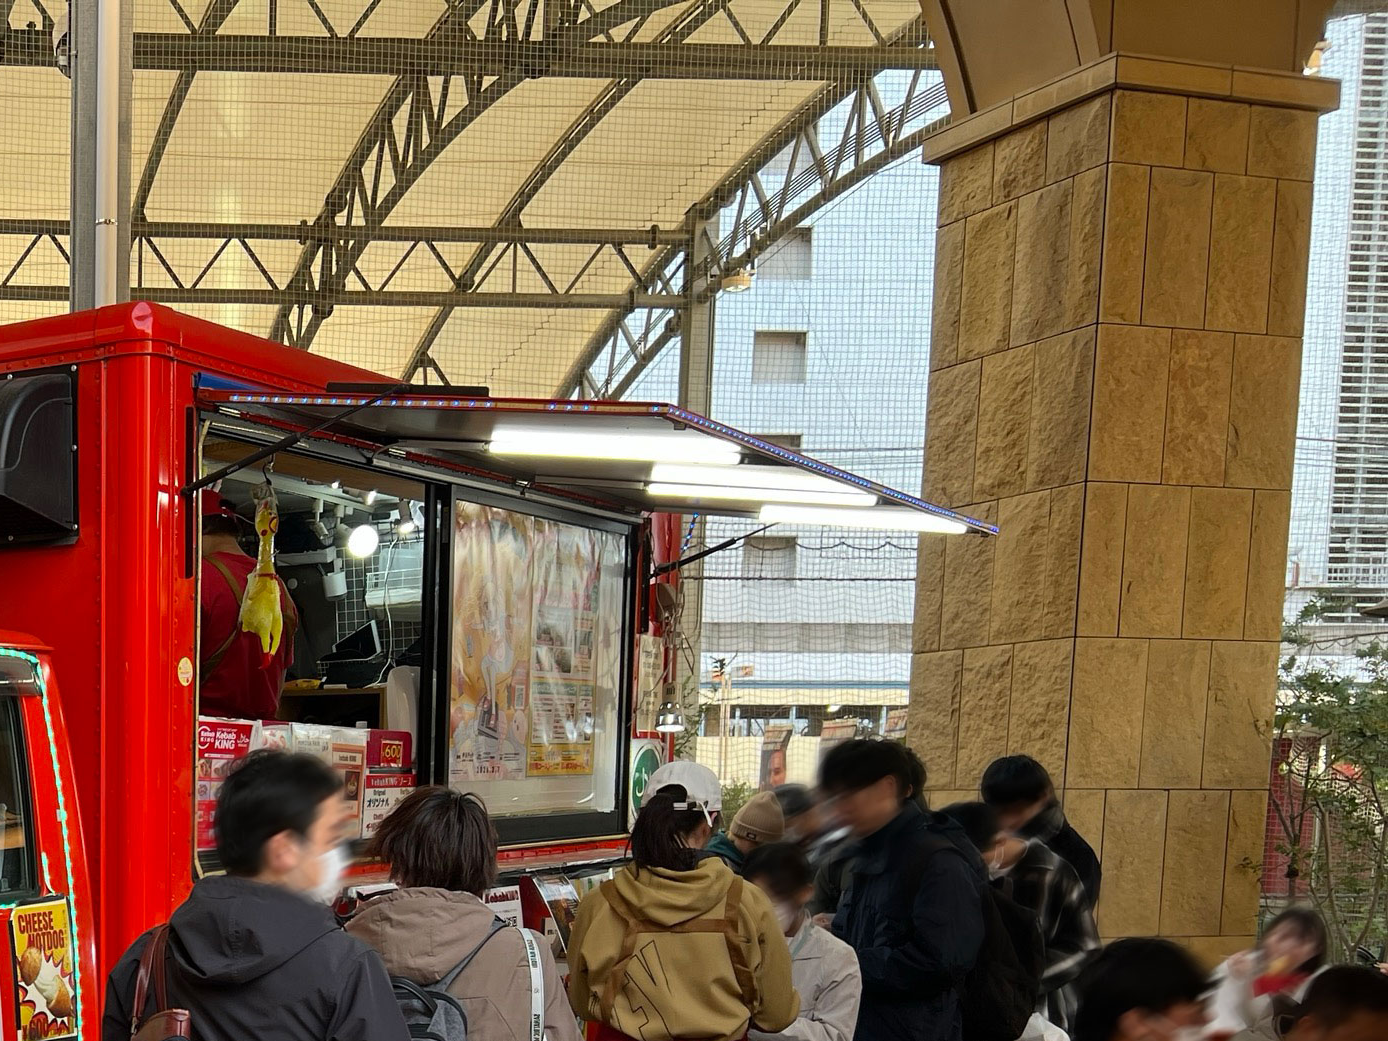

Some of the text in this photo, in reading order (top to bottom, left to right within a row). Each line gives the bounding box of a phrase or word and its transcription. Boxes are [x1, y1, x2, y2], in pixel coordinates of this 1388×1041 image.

[214, 739, 235, 750] KING
[366, 797, 390, 808] オリジナル
[17, 910, 54, 935] CHEESE
[27, 928, 65, 951] HOTDOG
